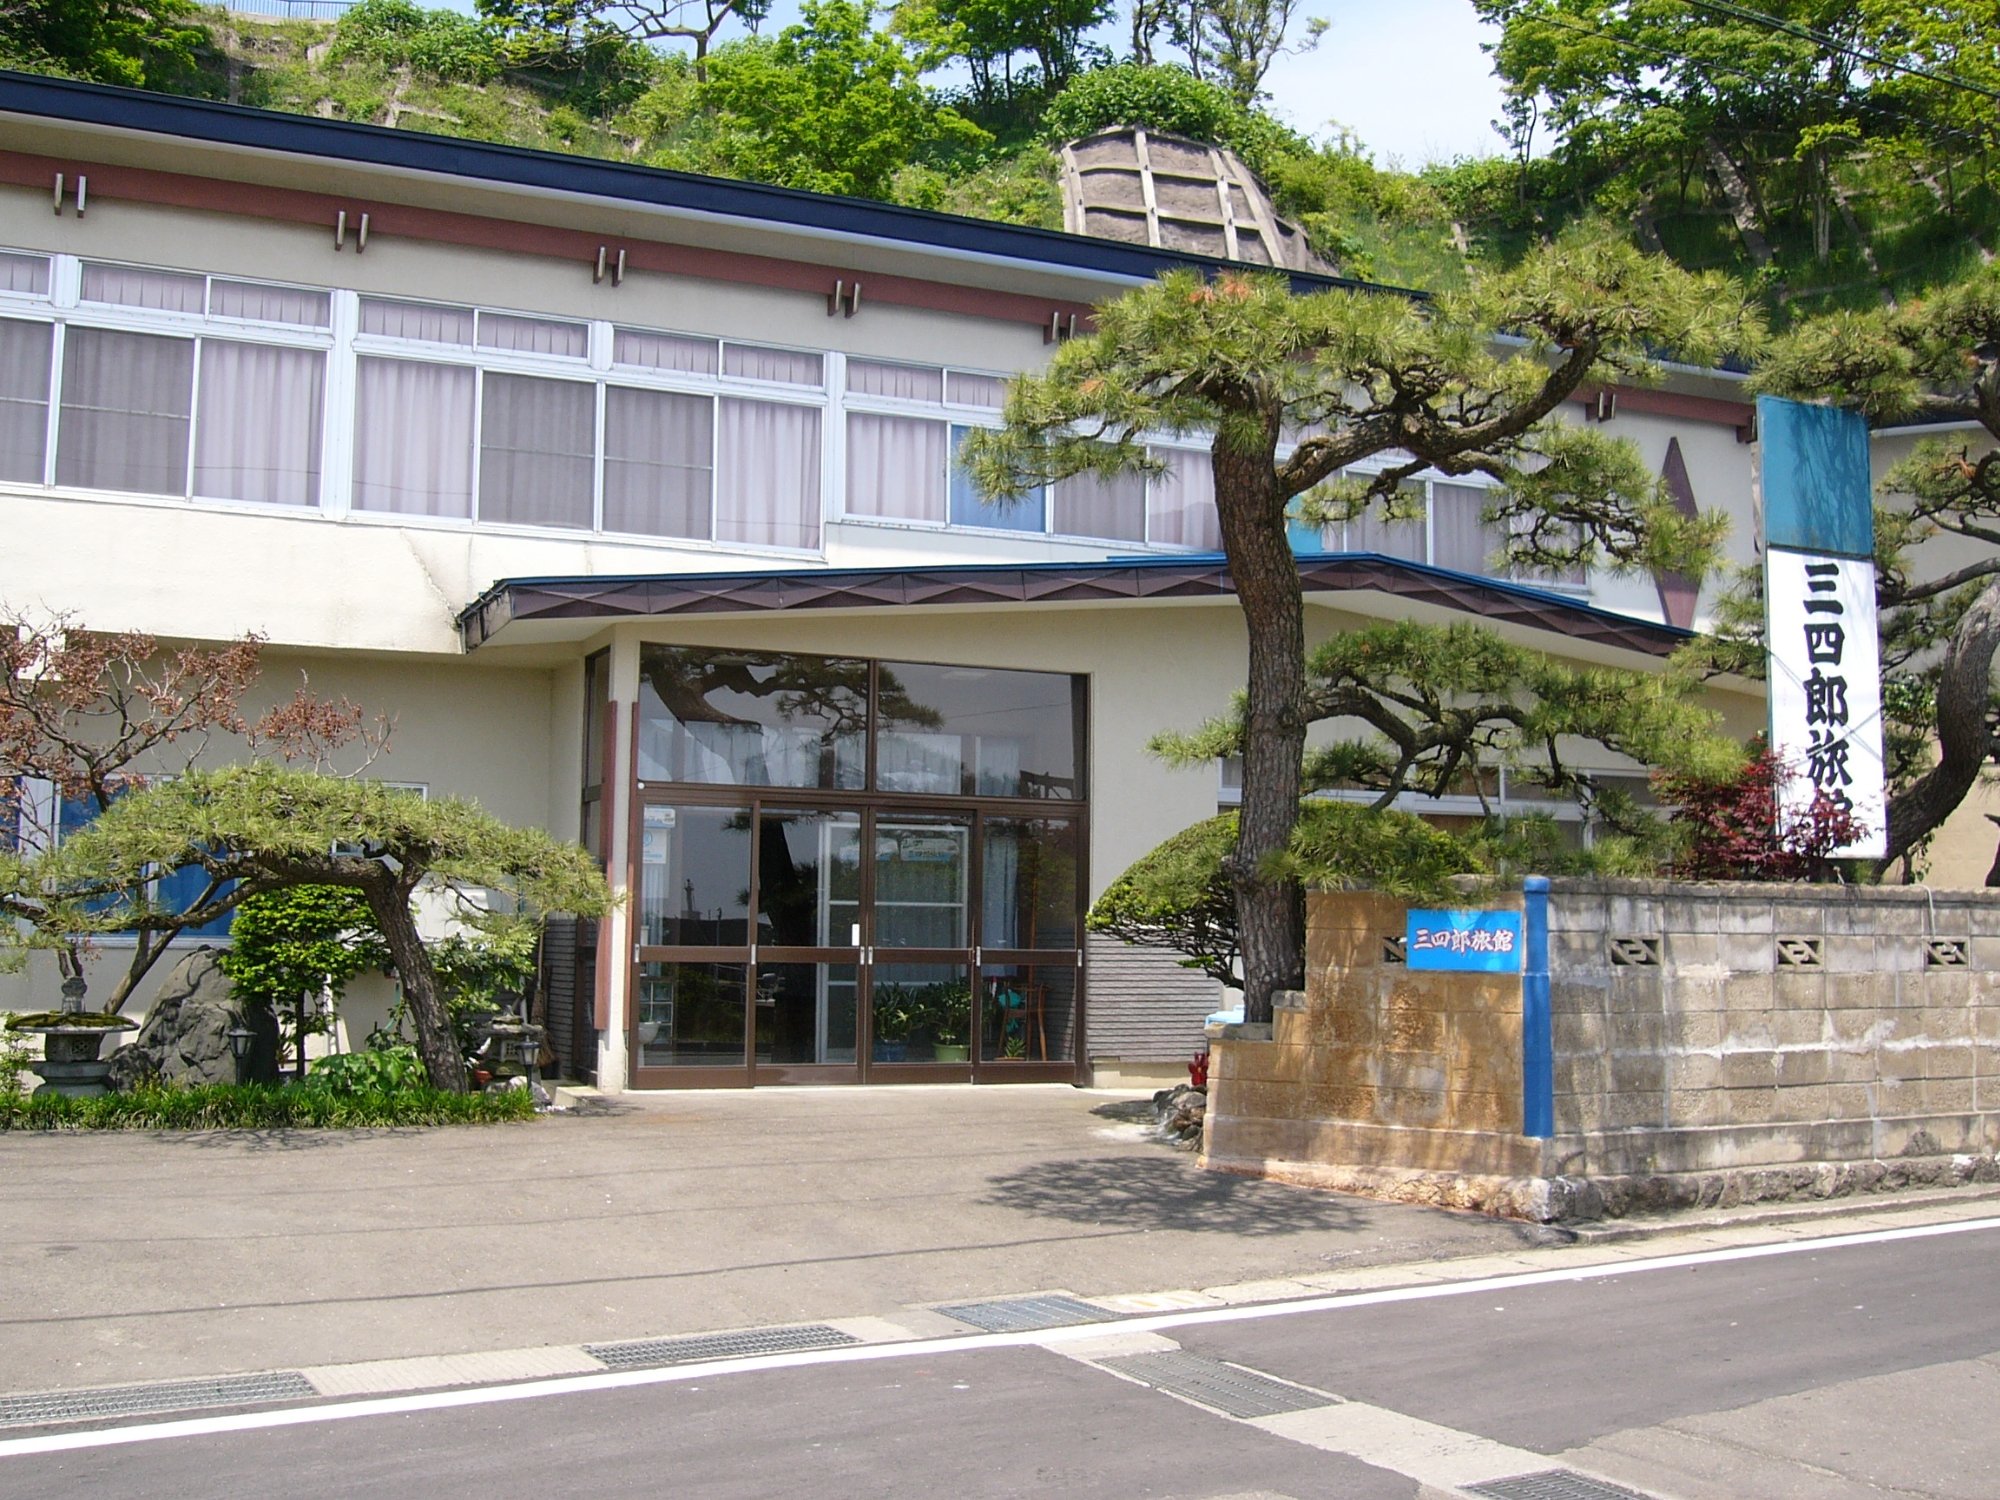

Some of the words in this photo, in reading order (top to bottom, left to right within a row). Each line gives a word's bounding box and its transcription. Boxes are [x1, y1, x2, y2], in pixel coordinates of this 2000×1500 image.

[1413, 928, 1514, 954] 三四郎旅館
